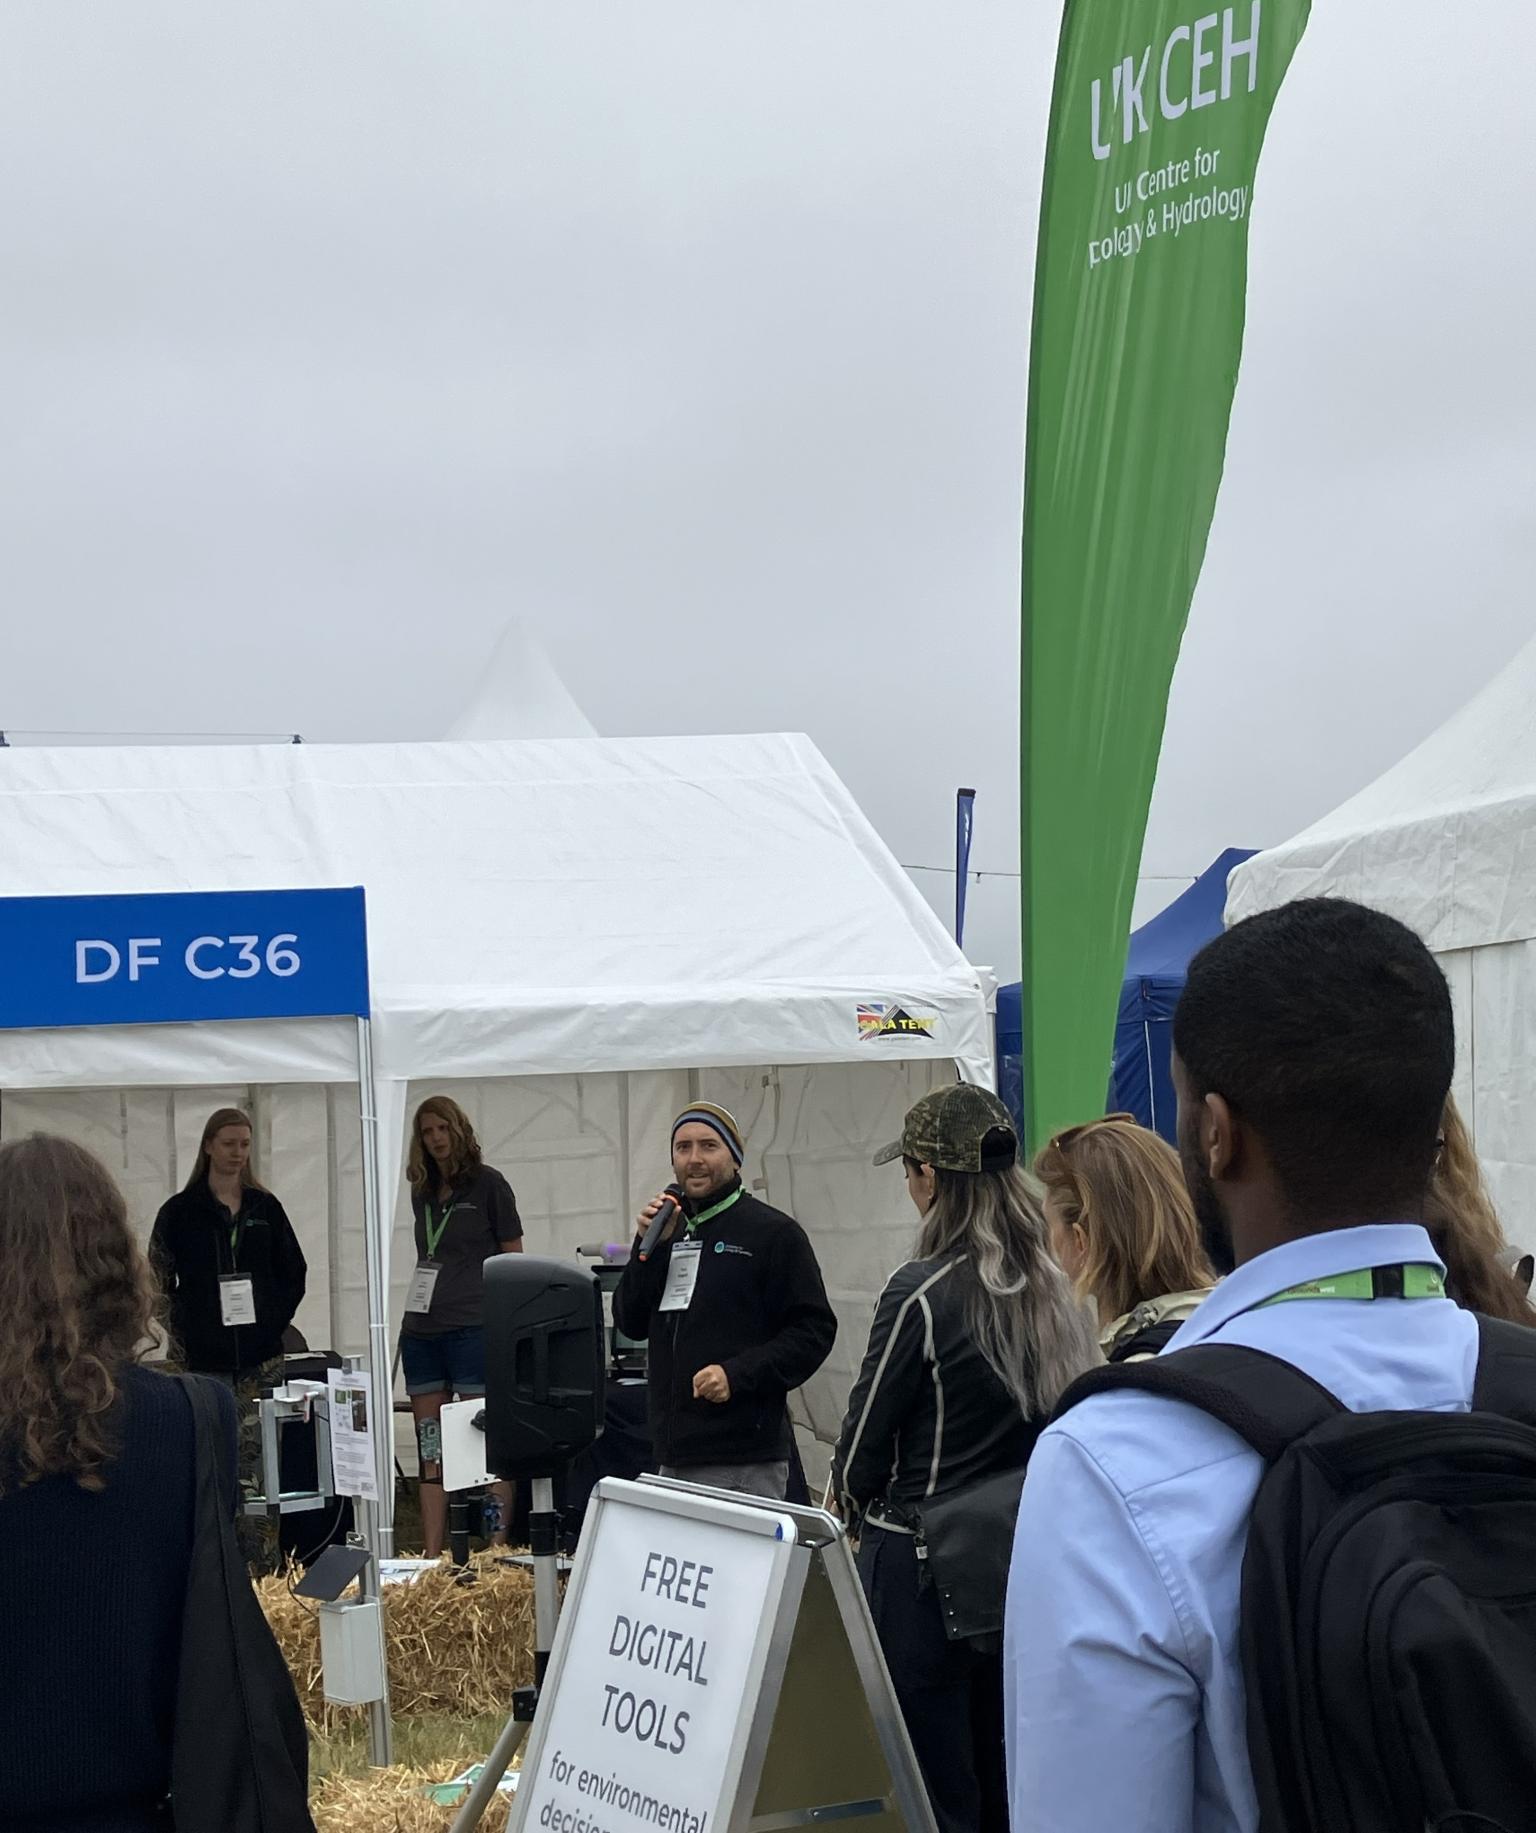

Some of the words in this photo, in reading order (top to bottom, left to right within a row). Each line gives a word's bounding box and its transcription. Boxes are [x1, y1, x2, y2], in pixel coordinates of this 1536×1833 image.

[1136, 159, 1190, 200] Centre
[1194, 146, 1221, 179] for
[1146, 208, 1157, 238] &
[1162, 184, 1249, 237] Hydrology
[75, 938, 162, 983] DF
[184, 933, 300, 980] C36
[640, 1552, 714, 1609] FREE
[608, 1615, 708, 1686] DIGITAL
[601, 1684, 690, 1755] TOOLS
[550, 1750, 575, 1786] for
[577, 1769, 708, 1833] environmental
